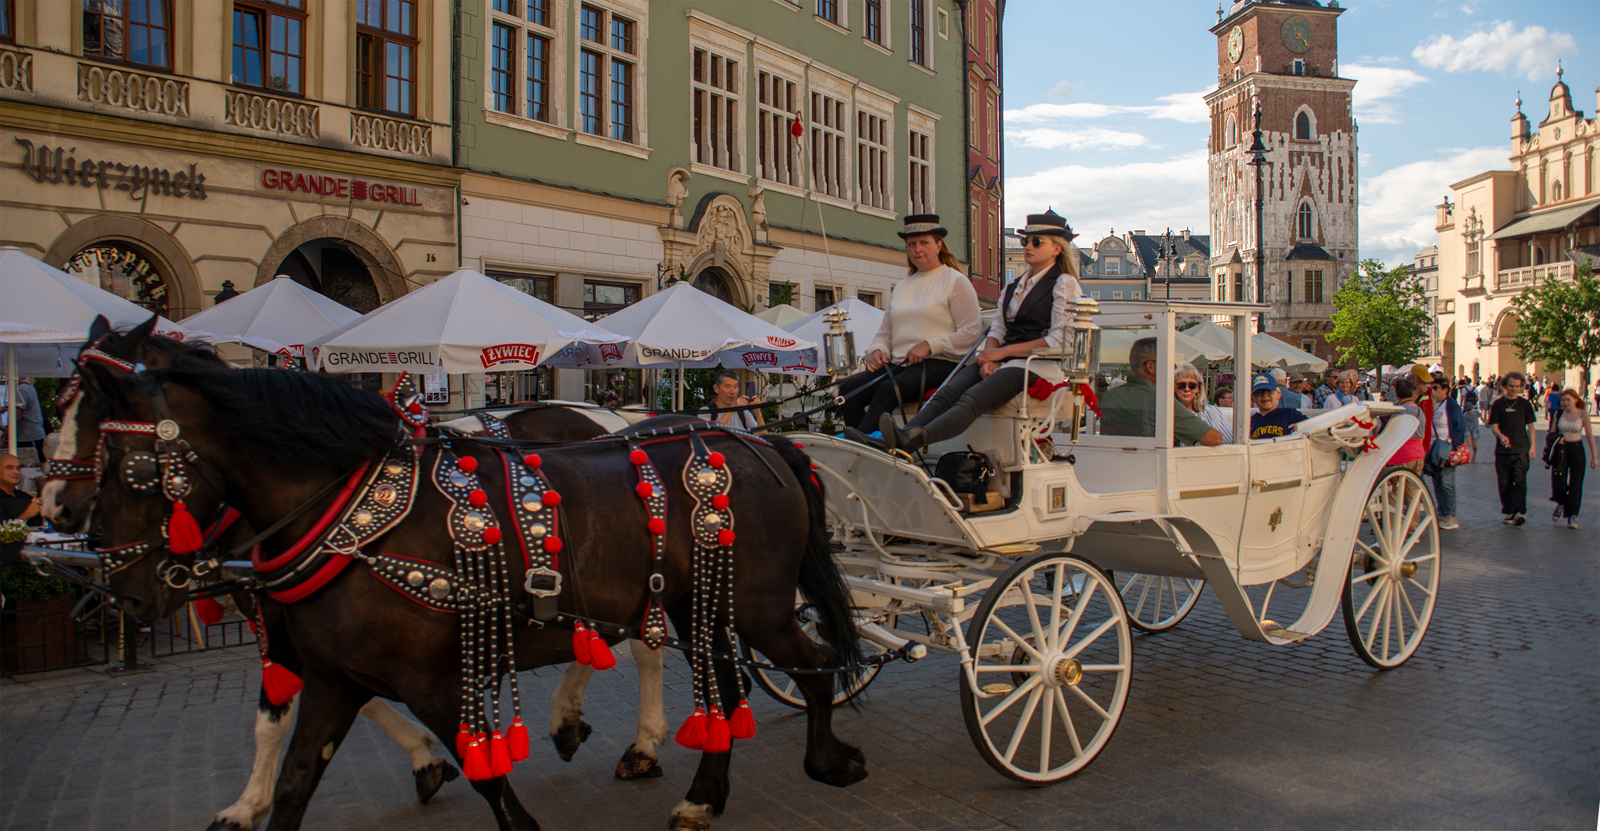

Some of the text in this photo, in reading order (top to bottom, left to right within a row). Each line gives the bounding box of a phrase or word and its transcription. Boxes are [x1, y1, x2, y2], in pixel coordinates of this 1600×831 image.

[14, 136, 208, 200] Wierzynek
[262, 169, 422, 206] GRANDE GRILL
[426, 253, 437, 262] 16
[69, 246, 168, 300] ierzynek
[328, 352, 435, 365] GRANDE GRILL
[487, 344, 532, 360] ŻYWIEC
[642, 347, 700, 359] GRANDE
